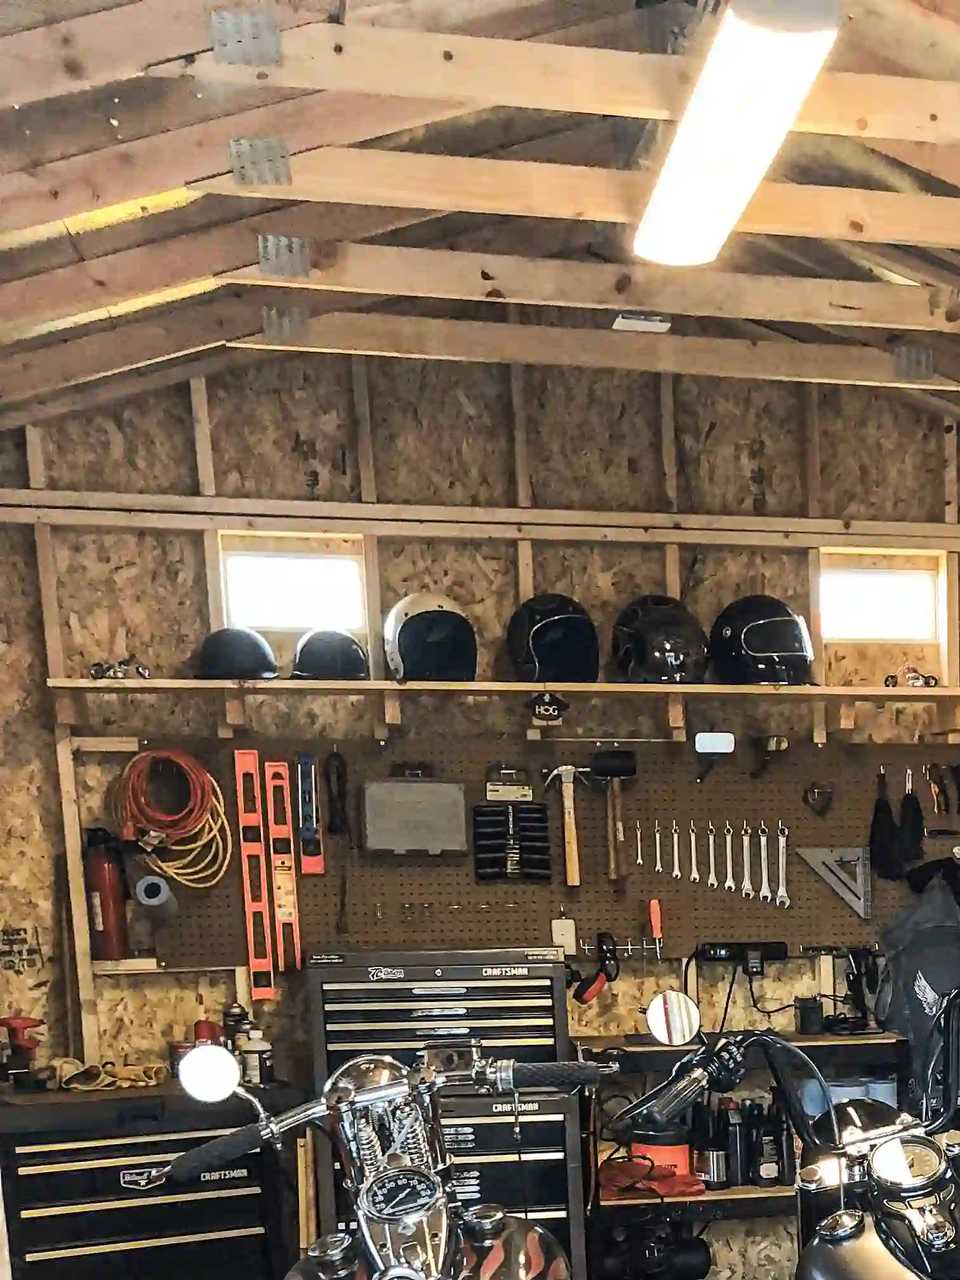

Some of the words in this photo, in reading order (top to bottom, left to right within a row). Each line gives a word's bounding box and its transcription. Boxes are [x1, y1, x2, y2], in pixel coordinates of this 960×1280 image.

[536, 705, 558, 715] HOG
[482, 967, 528, 976] CRAFTSMAN
[201, 1169, 248, 1181] CRAFTSMAN
